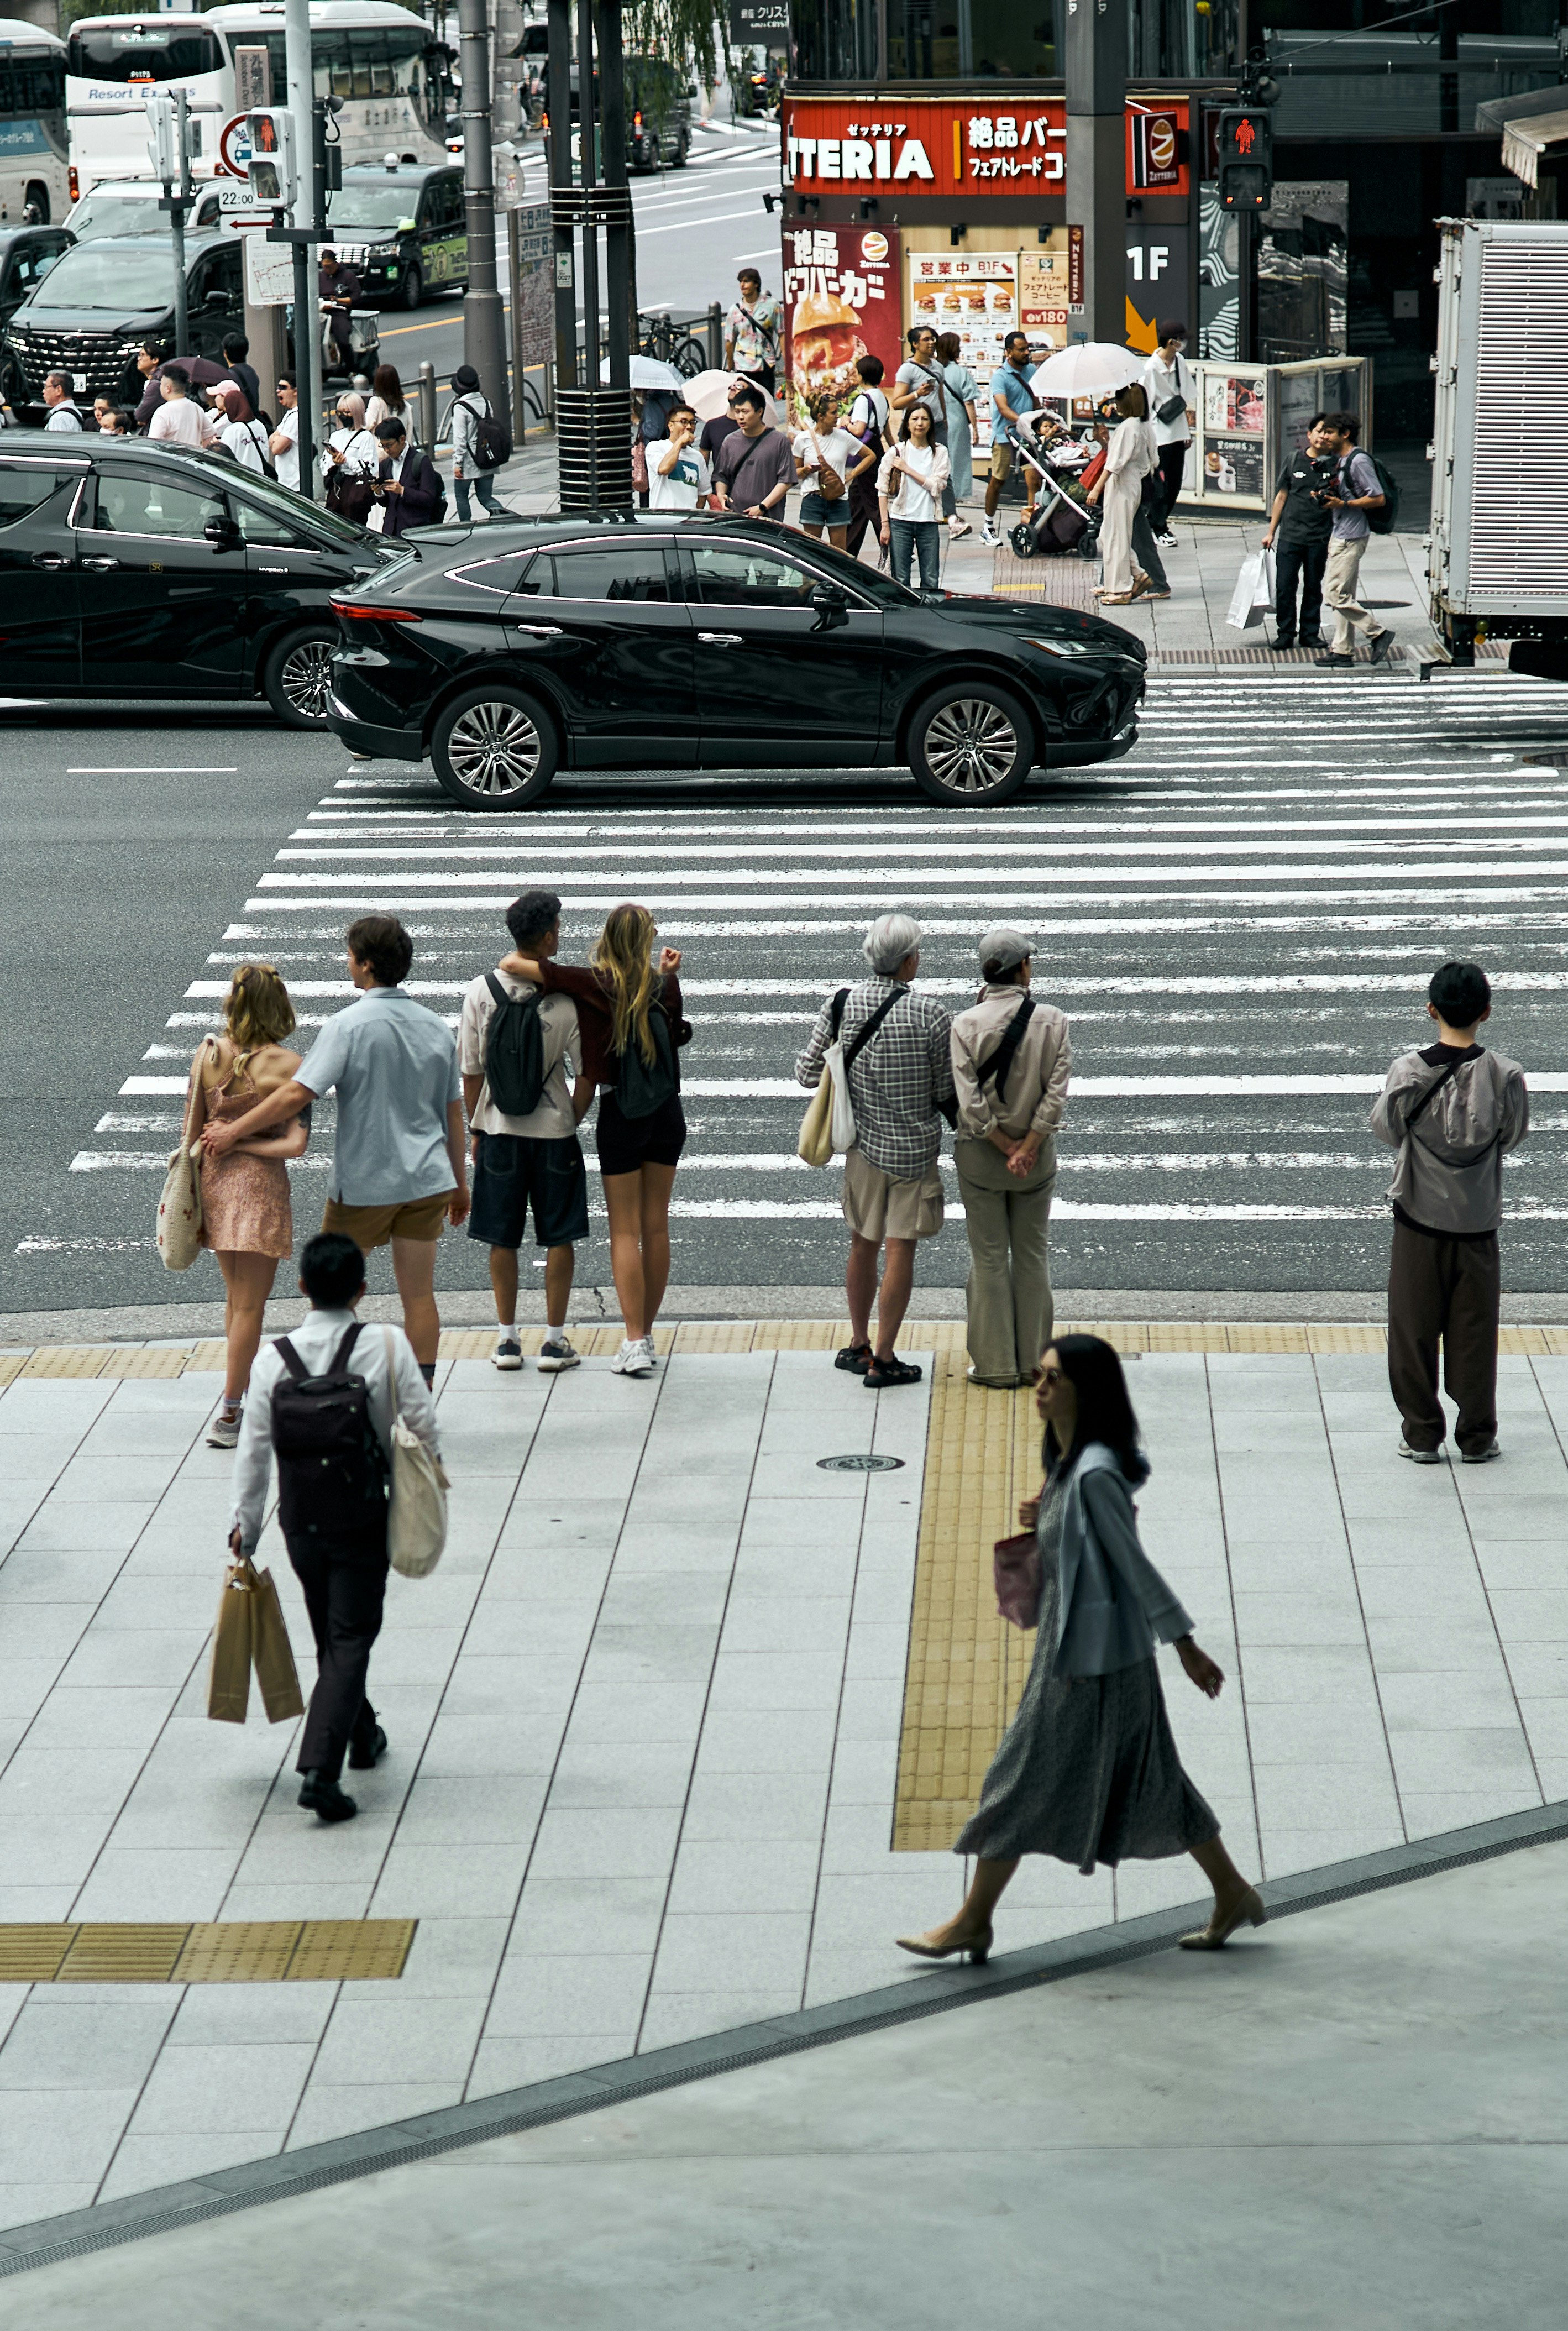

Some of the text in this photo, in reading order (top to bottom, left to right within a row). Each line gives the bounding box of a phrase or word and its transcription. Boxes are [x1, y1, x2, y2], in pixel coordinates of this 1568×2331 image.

[88, 88, 133, 99] Resort
[847, 123, 907, 137] ゼッテリア
[968, 152, 1067, 179] フェアトレードコ
[794, 229, 839, 267] 絶品
[921, 261, 970, 275] 営業中
[978, 261, 1000, 270] B1F
